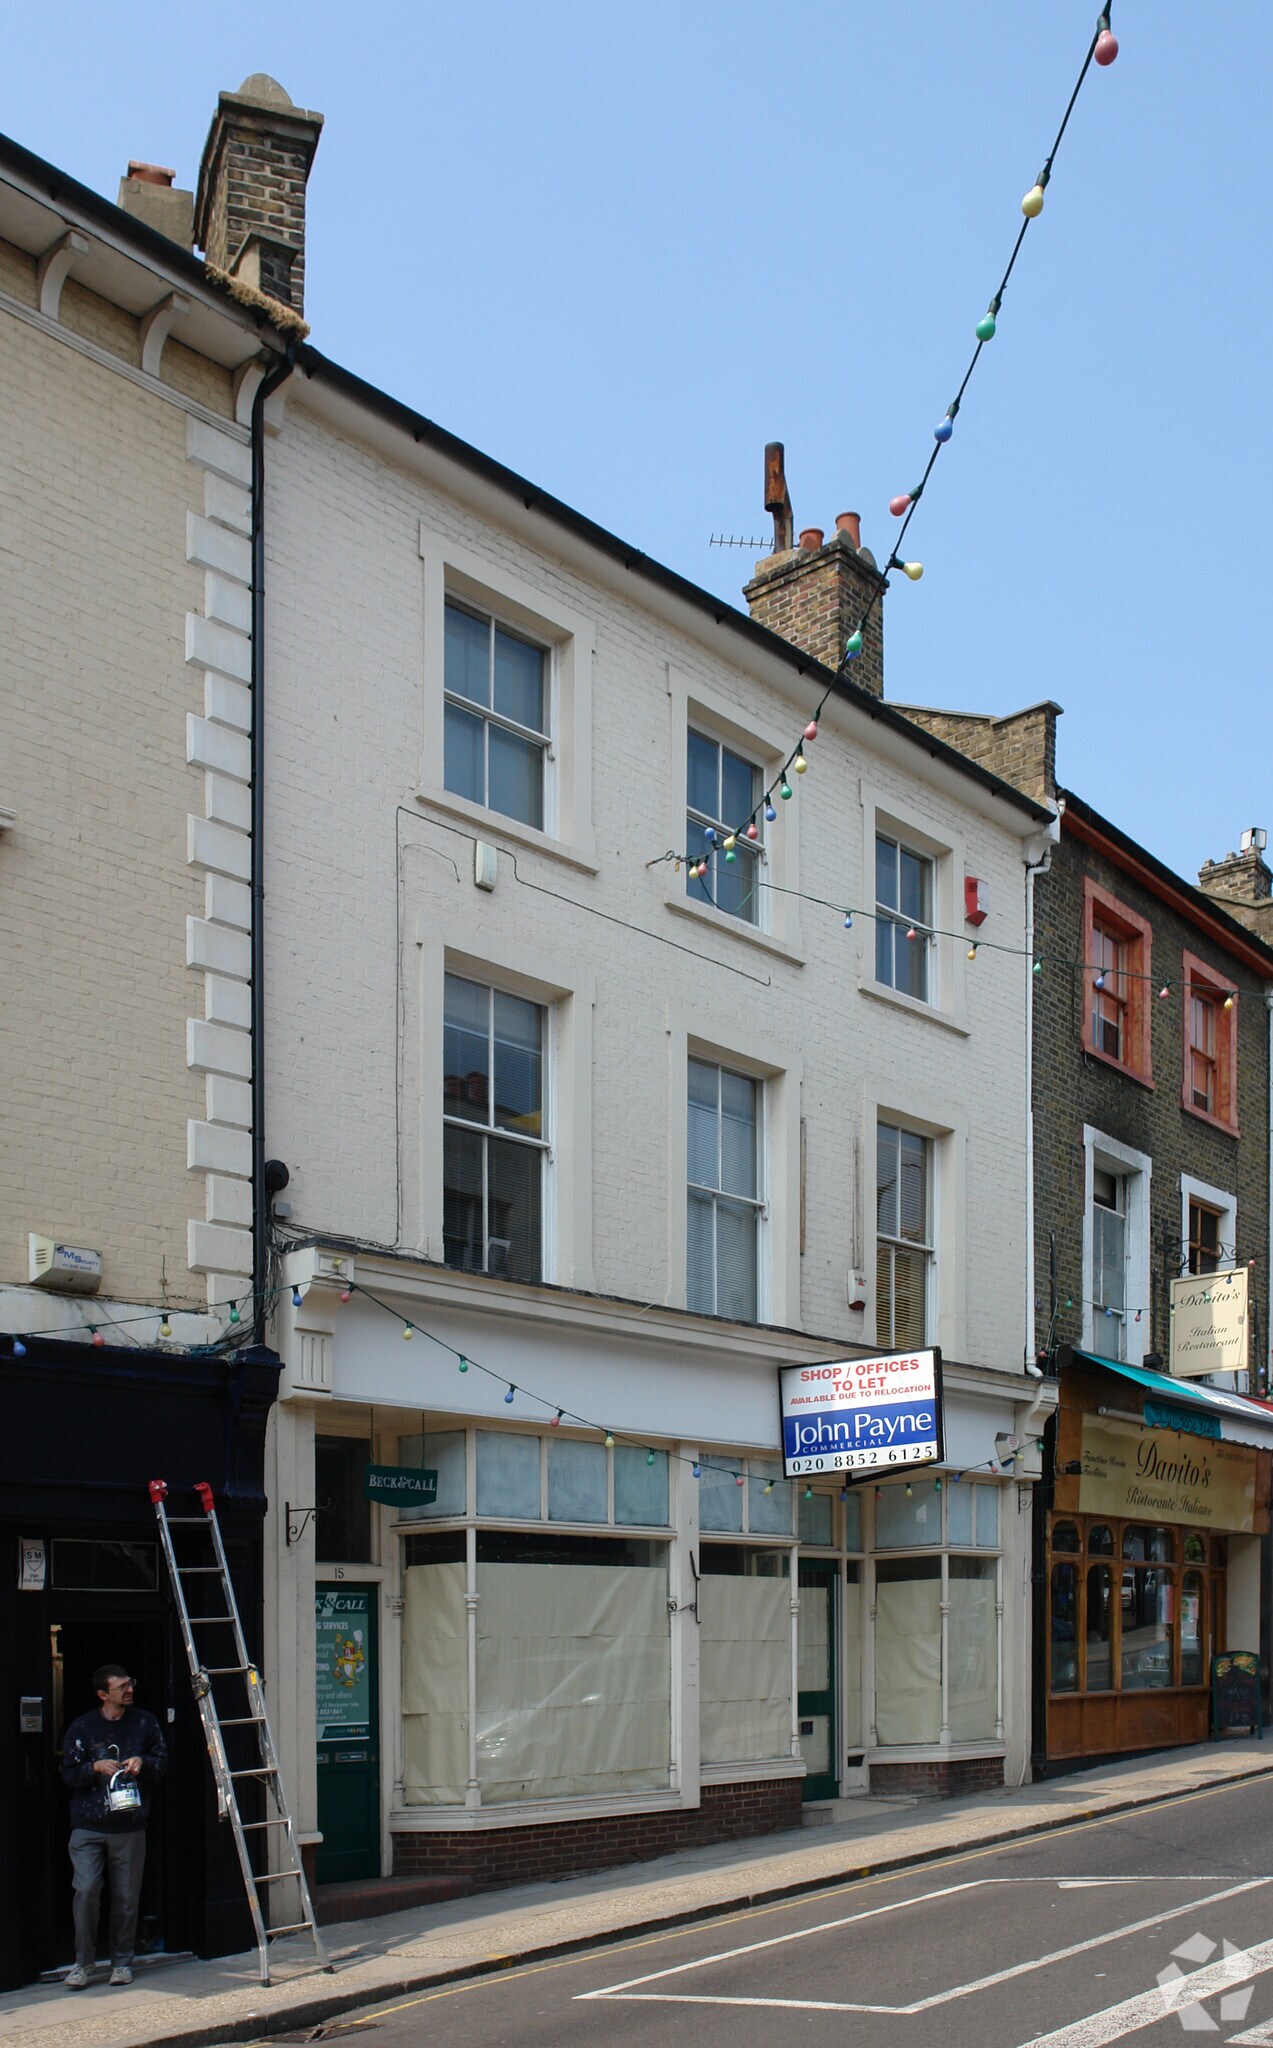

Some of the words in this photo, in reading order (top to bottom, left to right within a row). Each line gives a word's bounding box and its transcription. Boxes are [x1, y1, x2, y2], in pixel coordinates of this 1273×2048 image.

[1189, 1324, 1228, 1338] Italian
[1177, 1337, 1239, 1352] Restaurant
[801, 1368, 842, 1382] SHOP
[855, 1359, 919, 1376] OFFICES
[833, 1380, 853, 1392] TO
[859, 1377, 886, 1390] LET
[790, 1394, 836, 1405] AVAILABLE
[839, 1392, 856, 1400] DUE
[860, 1390, 872, 1398] TO
[874, 1384, 931, 1396] RELOCATION
[793, 1417, 849, 1455] John
[854, 1412, 932, 1443] Payne
[802, 1438, 883, 1454] COMMERCIAL
[793, 1458, 824, 1473] 020
[834, 1452, 878, 1468] 8852
[888, 1446, 933, 1462] 6125
[1136, 1438, 1211, 1488] Davito's
[369, 1474, 436, 1492] BECK&CALL
[1126, 1485, 1176, 1511] Ristorante
[1177, 1494, 1213, 1517] Italiano
[334, 1567, 344, 1580] 15
[316, 1597, 365, 1610] K&CALL
[322, 1621, 349, 1630] SERVICES
